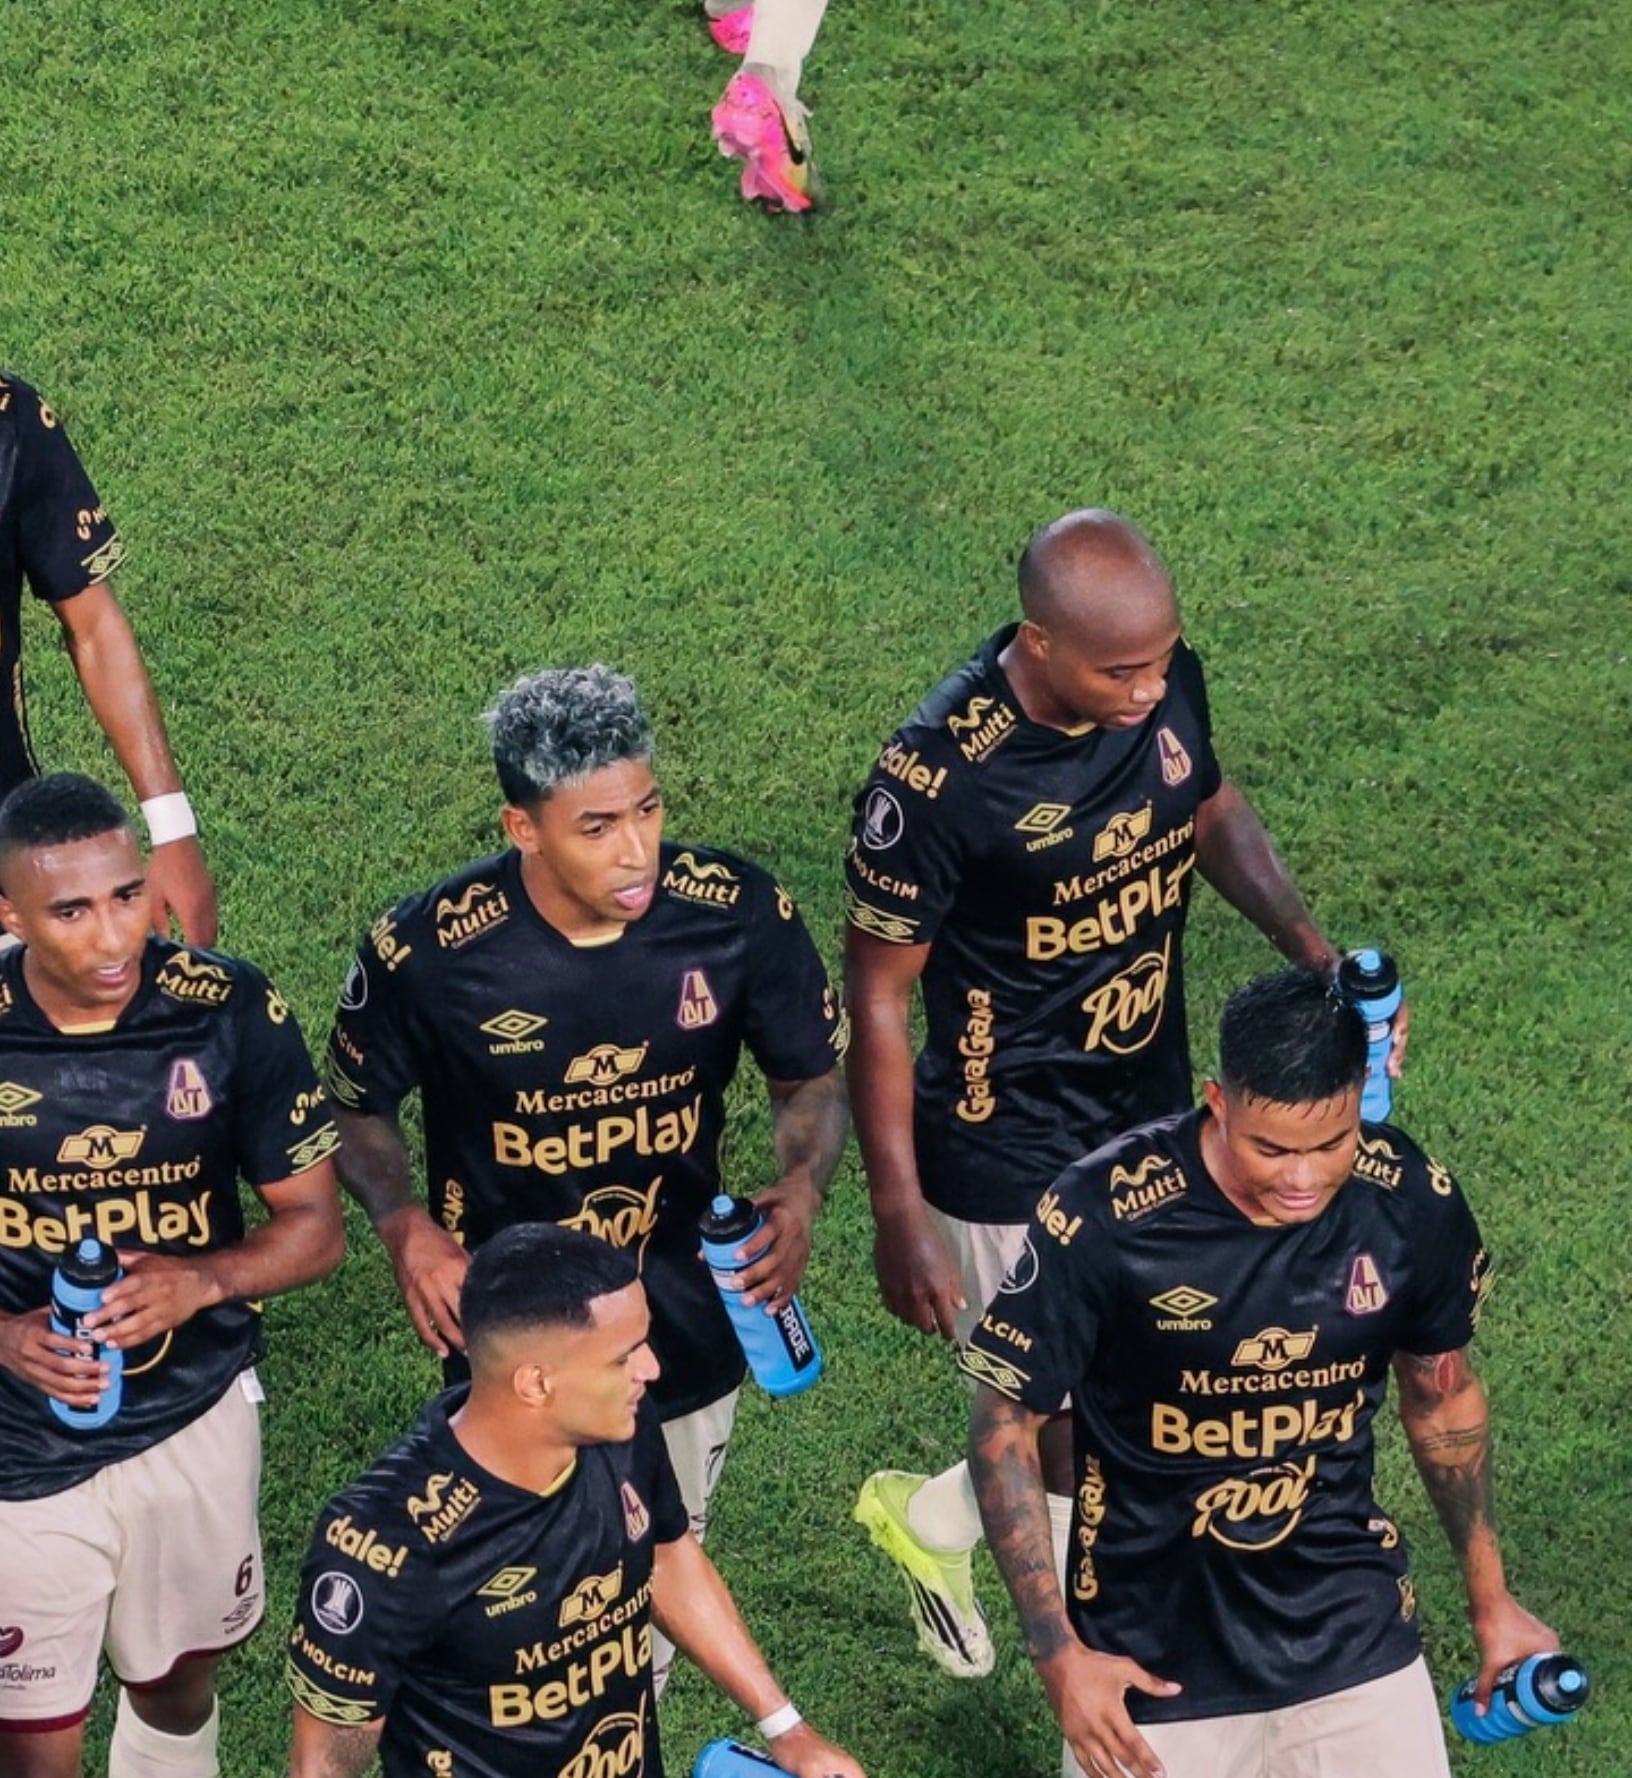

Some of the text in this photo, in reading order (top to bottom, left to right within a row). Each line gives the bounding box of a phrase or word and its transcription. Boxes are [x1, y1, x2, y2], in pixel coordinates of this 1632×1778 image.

[960, 702, 1017, 763] Multi
[1025, 827, 1074, 853] umbro
[661, 869, 743, 905] Multi
[436, 889, 511, 950] Multi
[155, 969, 234, 1002] Multi
[488, 1038, 545, 1056] umbro
[514, 1068, 695, 1116] Mercacentro
[491, 1094, 703, 1175] BetPlay
[7, 1159, 202, 1194] Mercacentro
[1111, 1166, 1188, 1221] Multi
[1156, 1317, 1213, 1332] umbro
[1179, 1358, 1366, 1397] Mercacentro
[421, 1476, 481, 1544] Multi
[325, 1515, 409, 1579] dale!
[234, 1553, 256, 1598] 6
[484, 1590, 539, 1618] umbro
[302, 1638, 376, 1687] HOLCIM
[488, 1622, 653, 1728] BetPla
